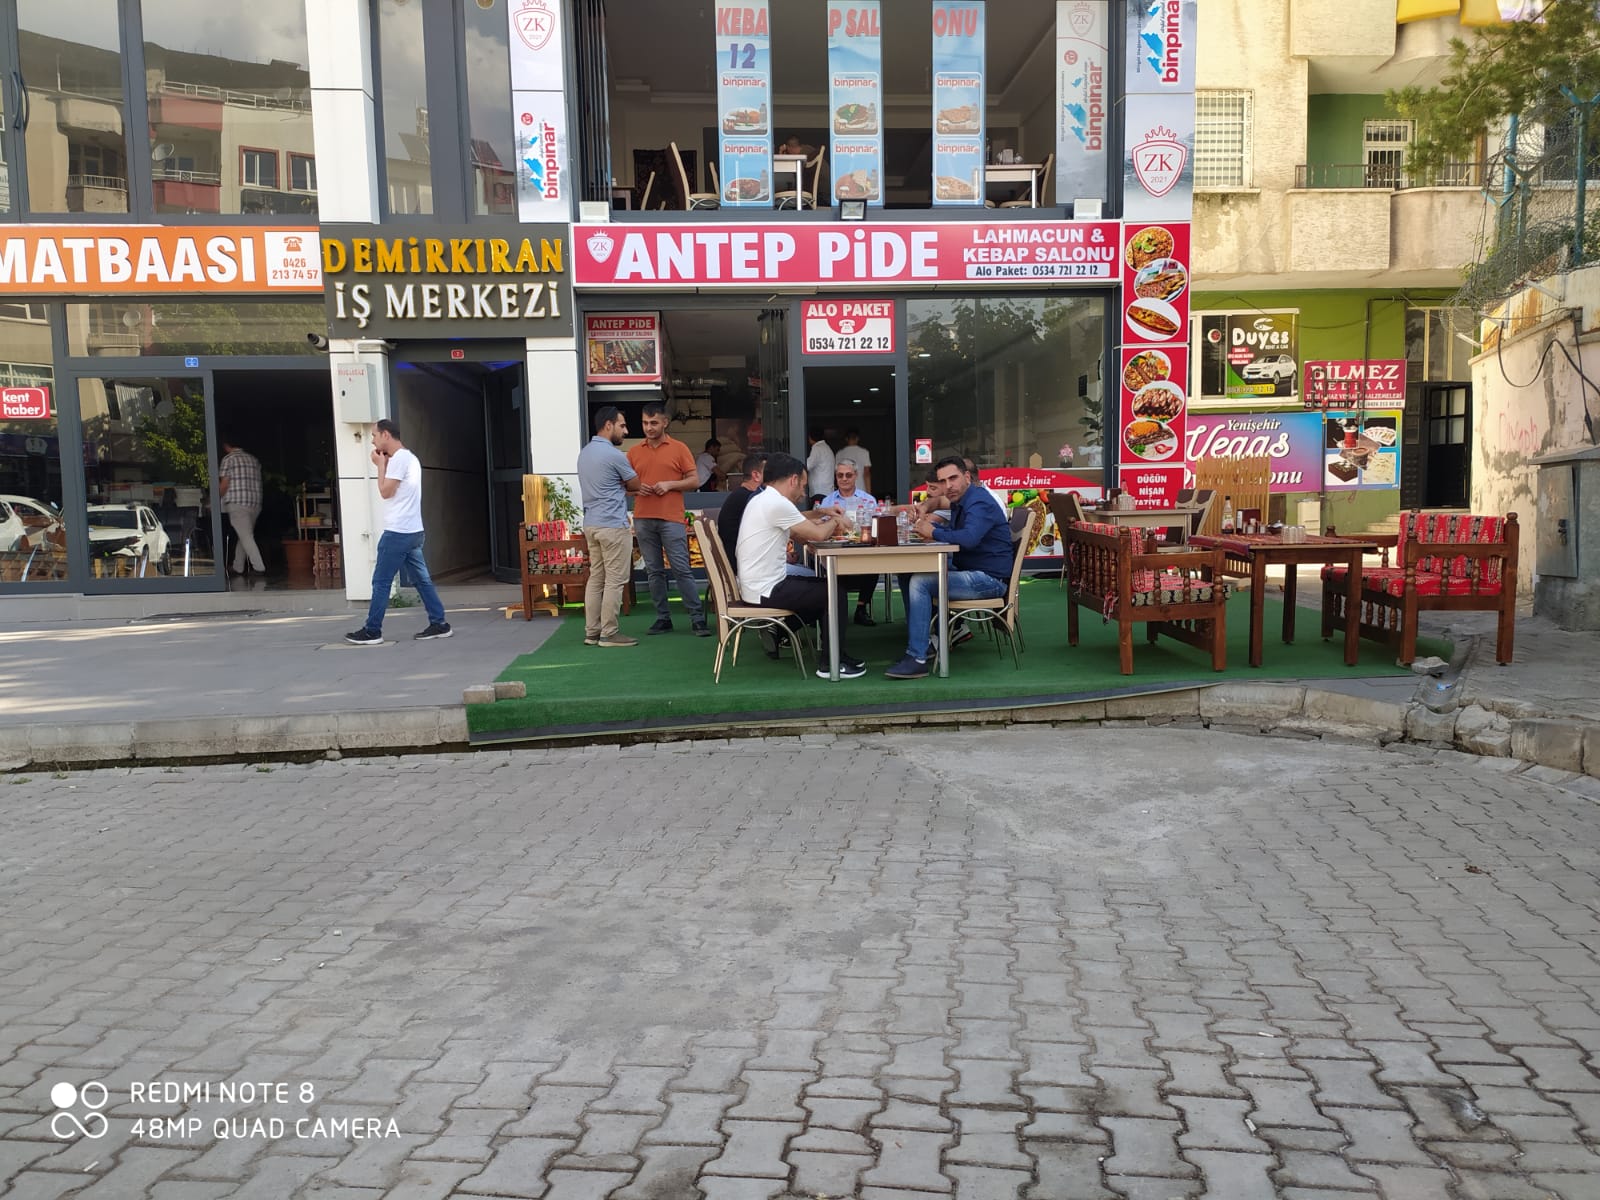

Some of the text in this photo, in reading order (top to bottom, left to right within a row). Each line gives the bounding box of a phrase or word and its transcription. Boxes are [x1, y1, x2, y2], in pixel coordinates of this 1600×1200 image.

[523, 18, 545, 31] ZK
[717, 7, 768, 36] KEBA
[828, 8, 880, 37] P SAL
[933, 8, 979, 37] ONU
[1162, 0, 1182, 82] binpına
[1144, 154, 1174, 171] ZK
[973, 228, 1104, 244] LAHMACUN &
[0, 236, 256, 283] MATBAASI
[614, 232, 796, 280] ANTEP
[963, 246, 1115, 262] KEBAP SALONU
[283, 257, 306, 268] 0426
[272, 269, 318, 280] 213 74 57
[976, 265, 1098, 276] Alo Paket: 0534 721 22 12
[335, 281, 371, 328] İŞ
[806, 303, 890, 317] ALO PAKET
[592, 319, 625, 329] ANTEP
[809, 337, 889, 350] 0534 721 22 12
[1232, 328, 1289, 350] Duyes
[1310, 362, 1399, 380] BİLMEZ
[2, 391, 30, 402] kent
[3, 404, 40, 415] haber
[1228, 419, 1280, 433] Yenişehir
[994, 475, 1020, 486] Bizim
[1137, 473, 1167, 484] DÜĞÜN
[1139, 485, 1164, 497] NİŞAN
